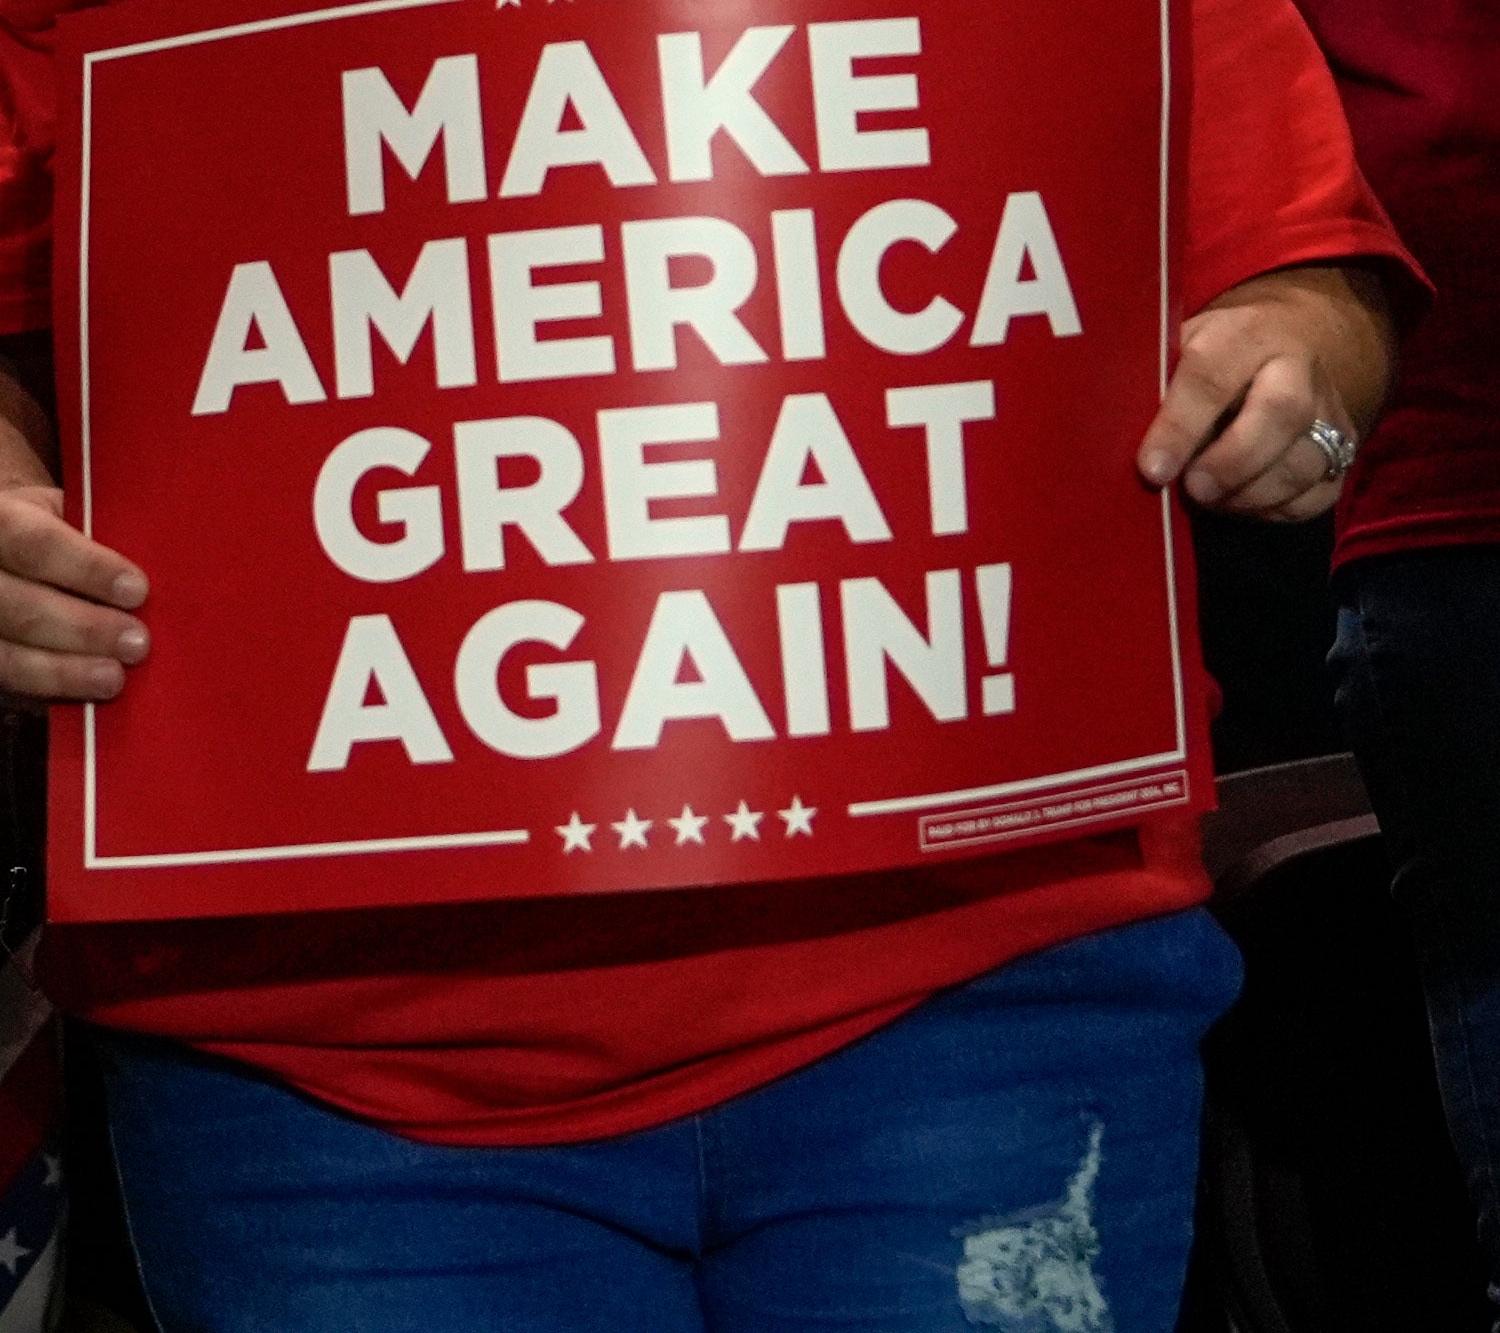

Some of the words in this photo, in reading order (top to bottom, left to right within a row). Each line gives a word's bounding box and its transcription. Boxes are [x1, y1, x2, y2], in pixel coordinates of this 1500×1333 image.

[340, 15, 932, 218] MAKE
[189, 189, 1083, 417] AMERICA
[311, 381, 996, 584] GREAT
[306, 561, 1017, 775] AGAIN!
